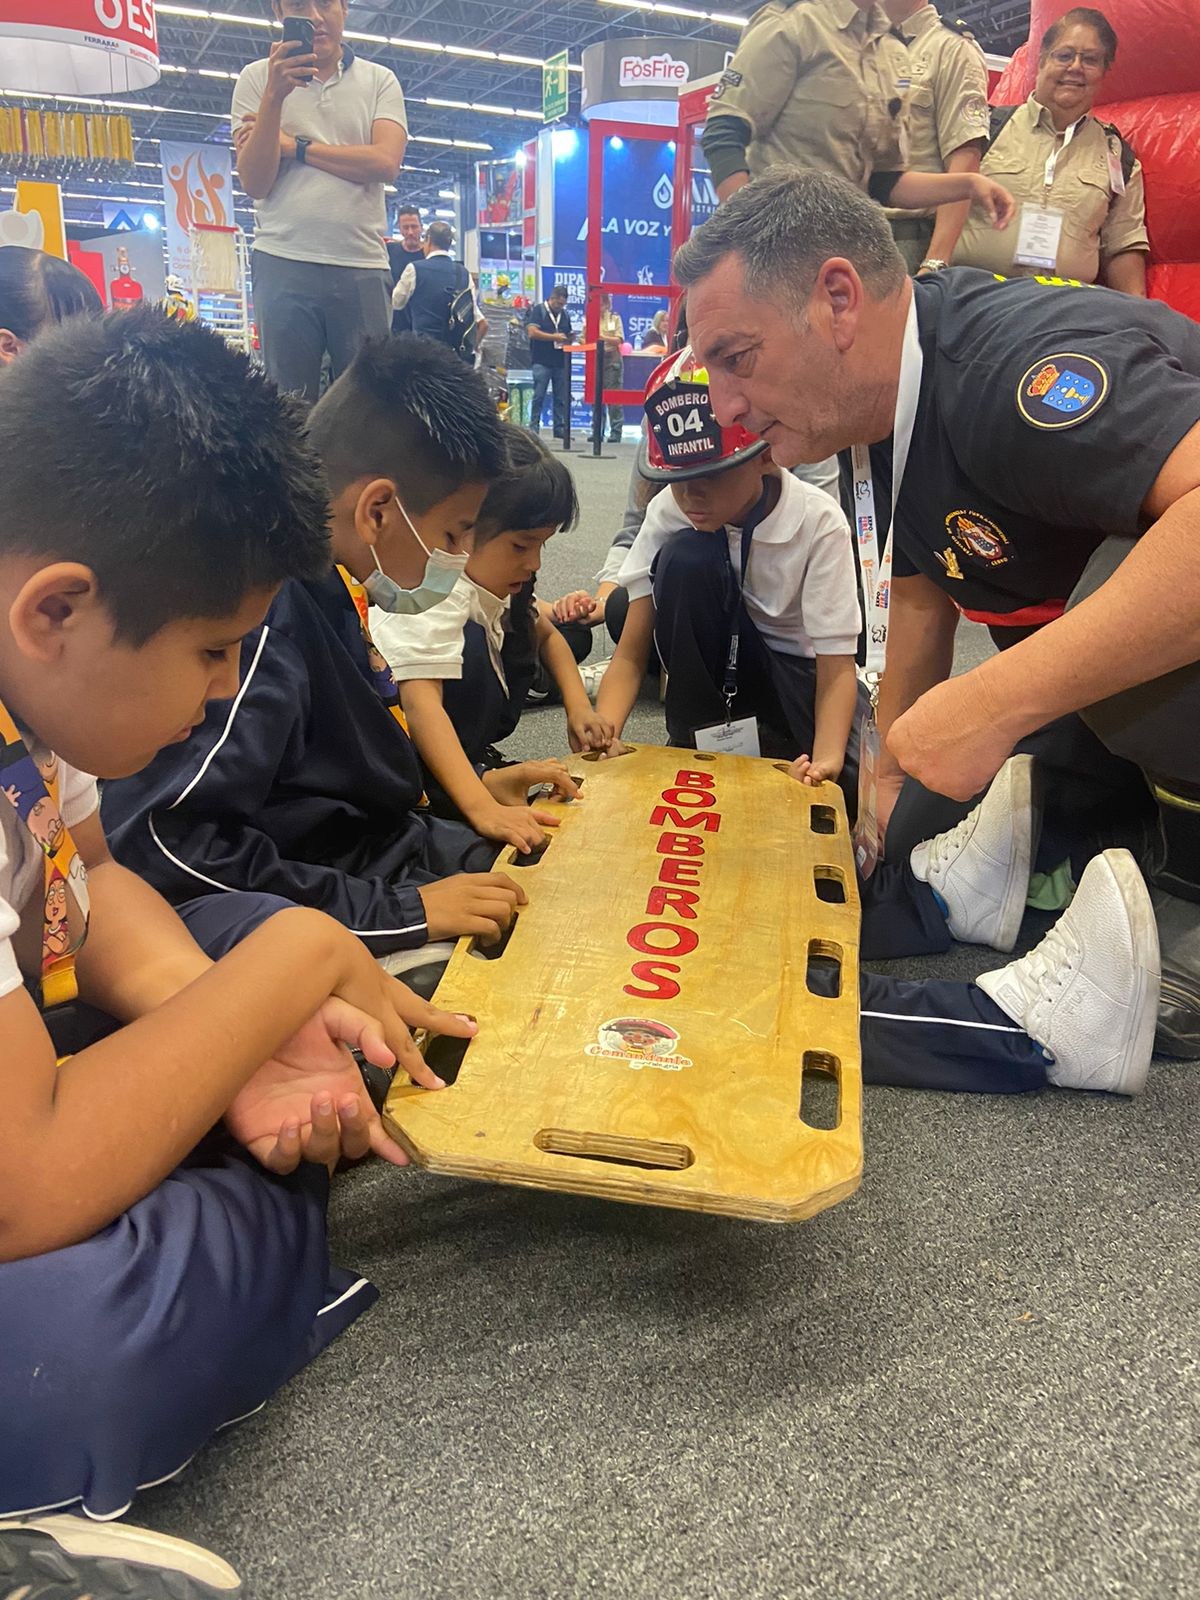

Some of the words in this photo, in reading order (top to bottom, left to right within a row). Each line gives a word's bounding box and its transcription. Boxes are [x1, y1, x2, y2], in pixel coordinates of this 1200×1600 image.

[623, 59, 686, 79] FosFire
[624, 219, 661, 236] VOZ
[554, 272, 586, 285] DIPA
[655, 393, 708, 417] BOMBERO
[667, 408, 704, 437] 04
[667, 437, 714, 456] INFANTIL
[622, 769, 722, 1000] BOMBEROS
[590, 1045, 689, 1066] Comandante
